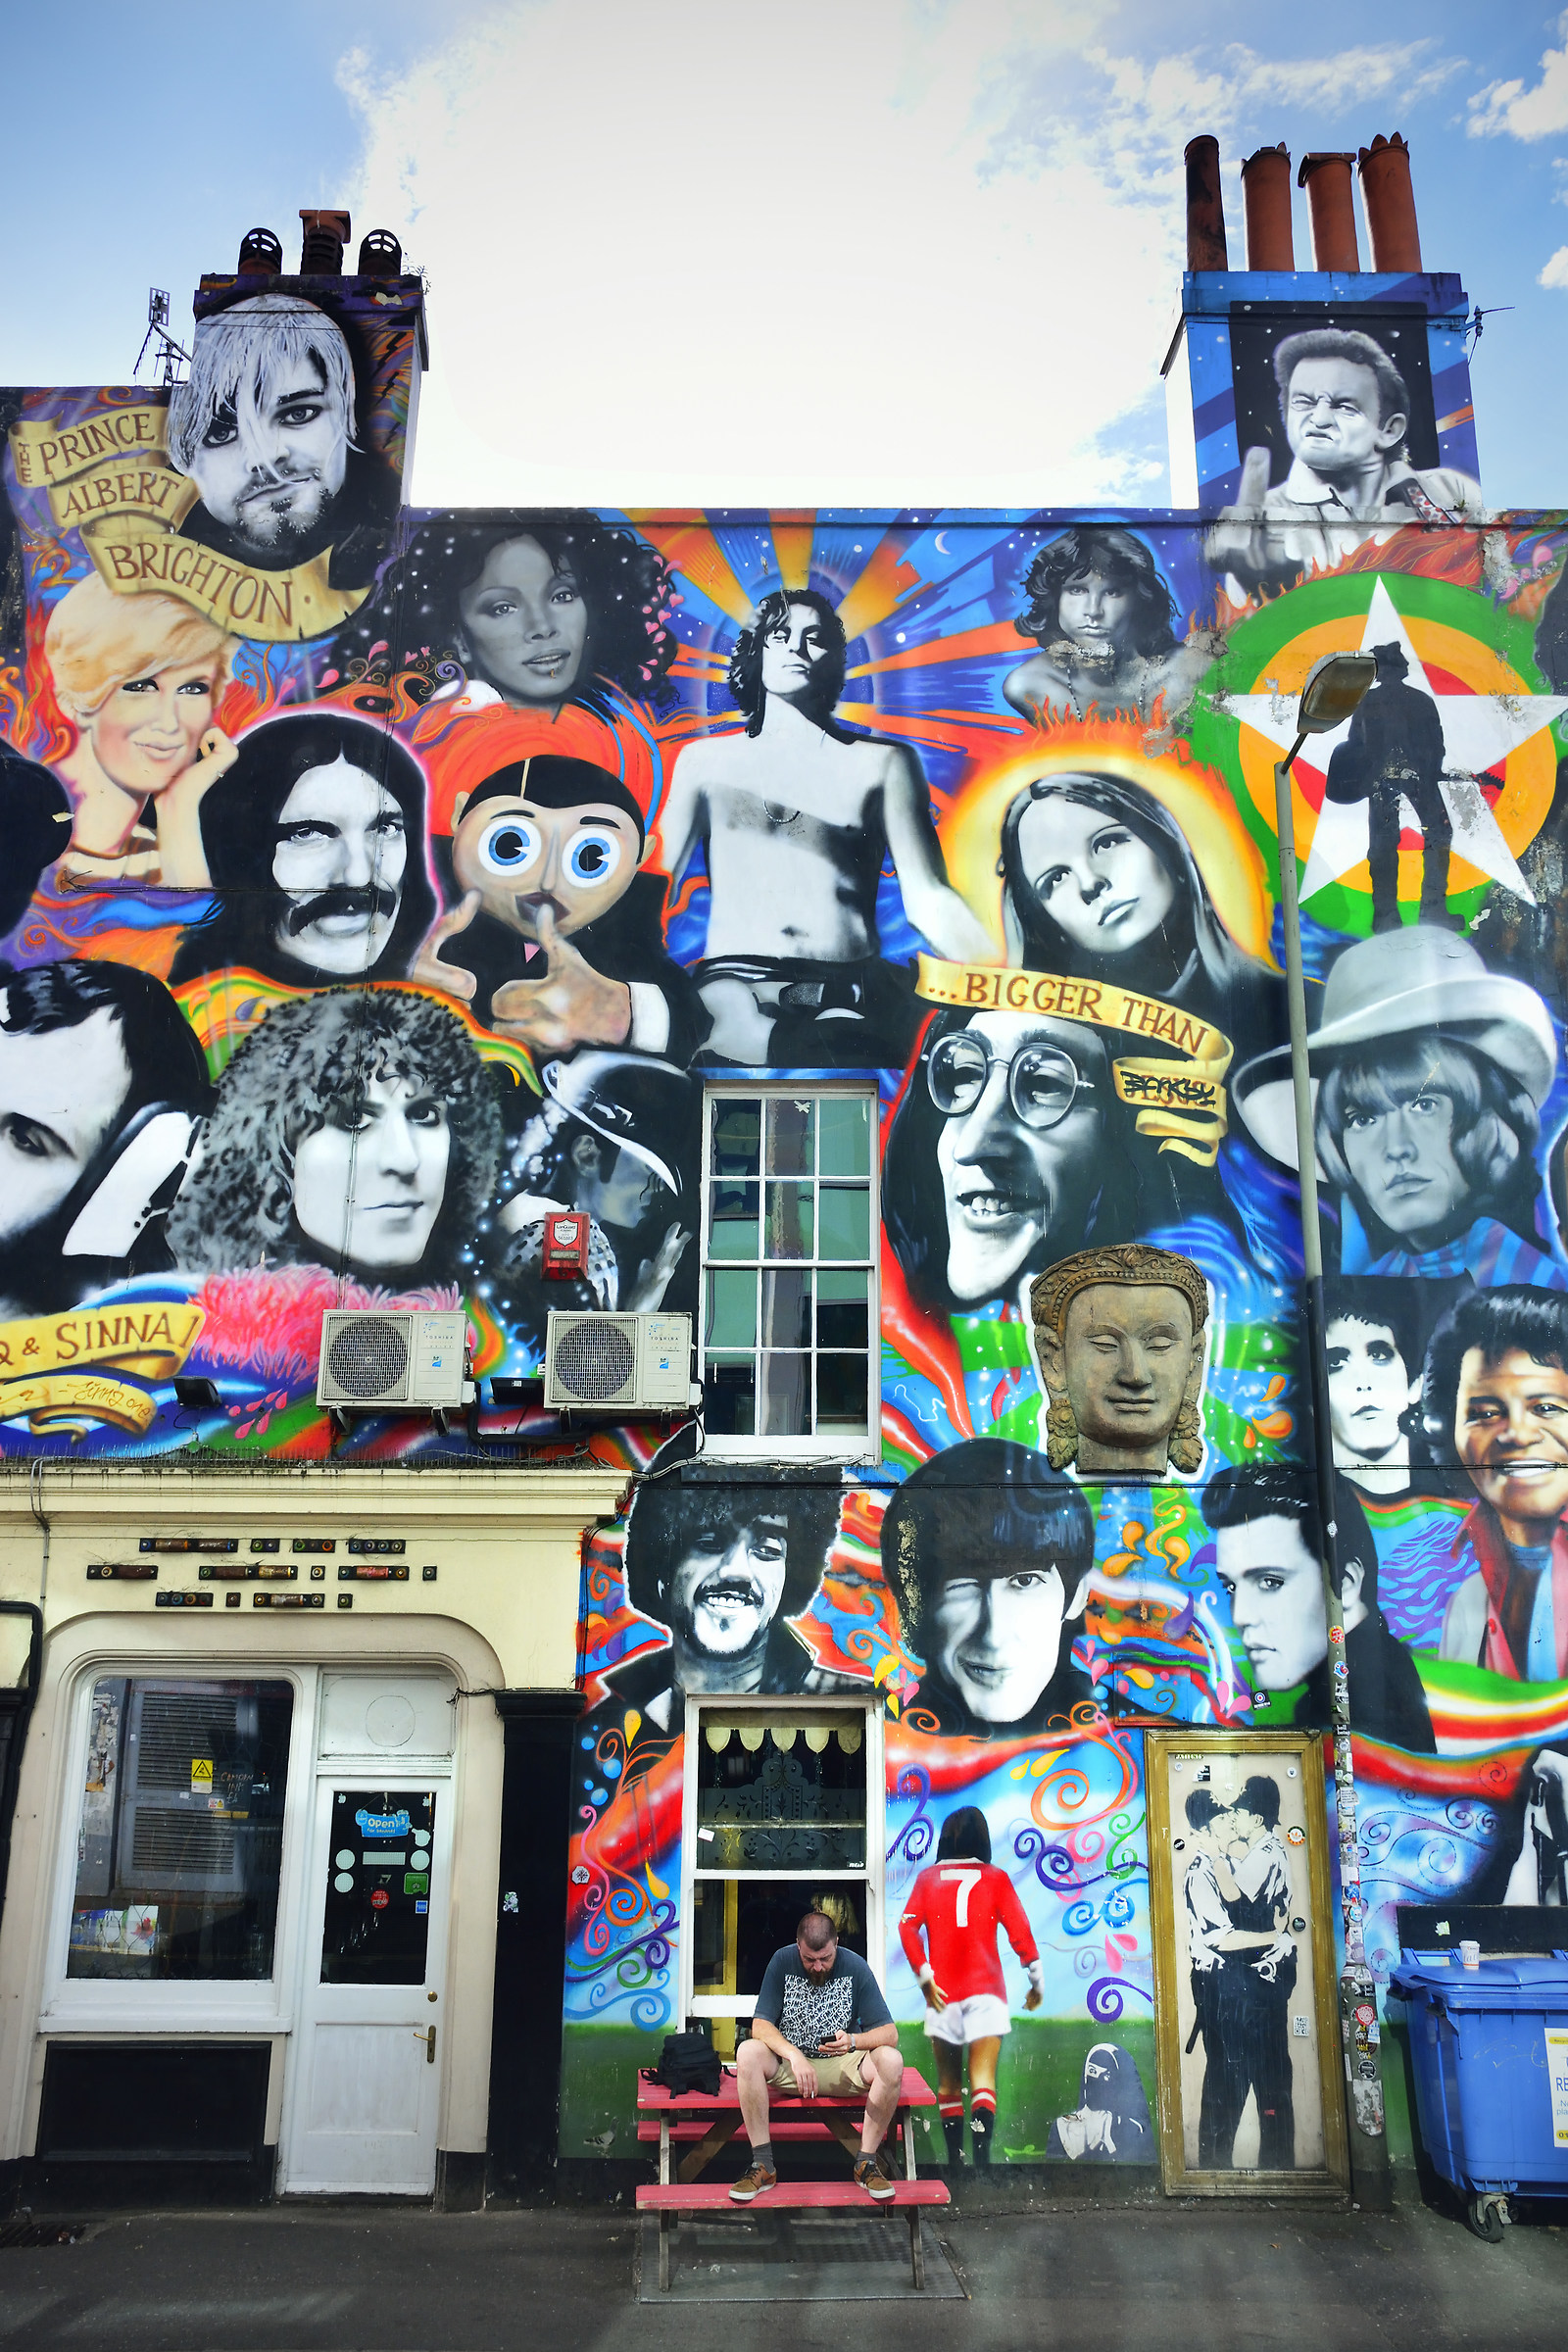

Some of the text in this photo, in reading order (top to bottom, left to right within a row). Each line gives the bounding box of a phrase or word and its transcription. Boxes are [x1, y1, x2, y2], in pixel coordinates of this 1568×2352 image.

[18, 442, 33, 484] THE
[37, 413, 156, 475] PRINCE
[62, 471, 180, 519] ALBERT
[105, 542, 293, 627] BRIGHTON
[1122, 996, 1209, 1054] THAN
[22, 1337, 40, 1356] &
[56, 1311, 176, 1360] SINNA
[368, 1818, 395, 1829] Open
[940, 1869, 982, 1928] 7
